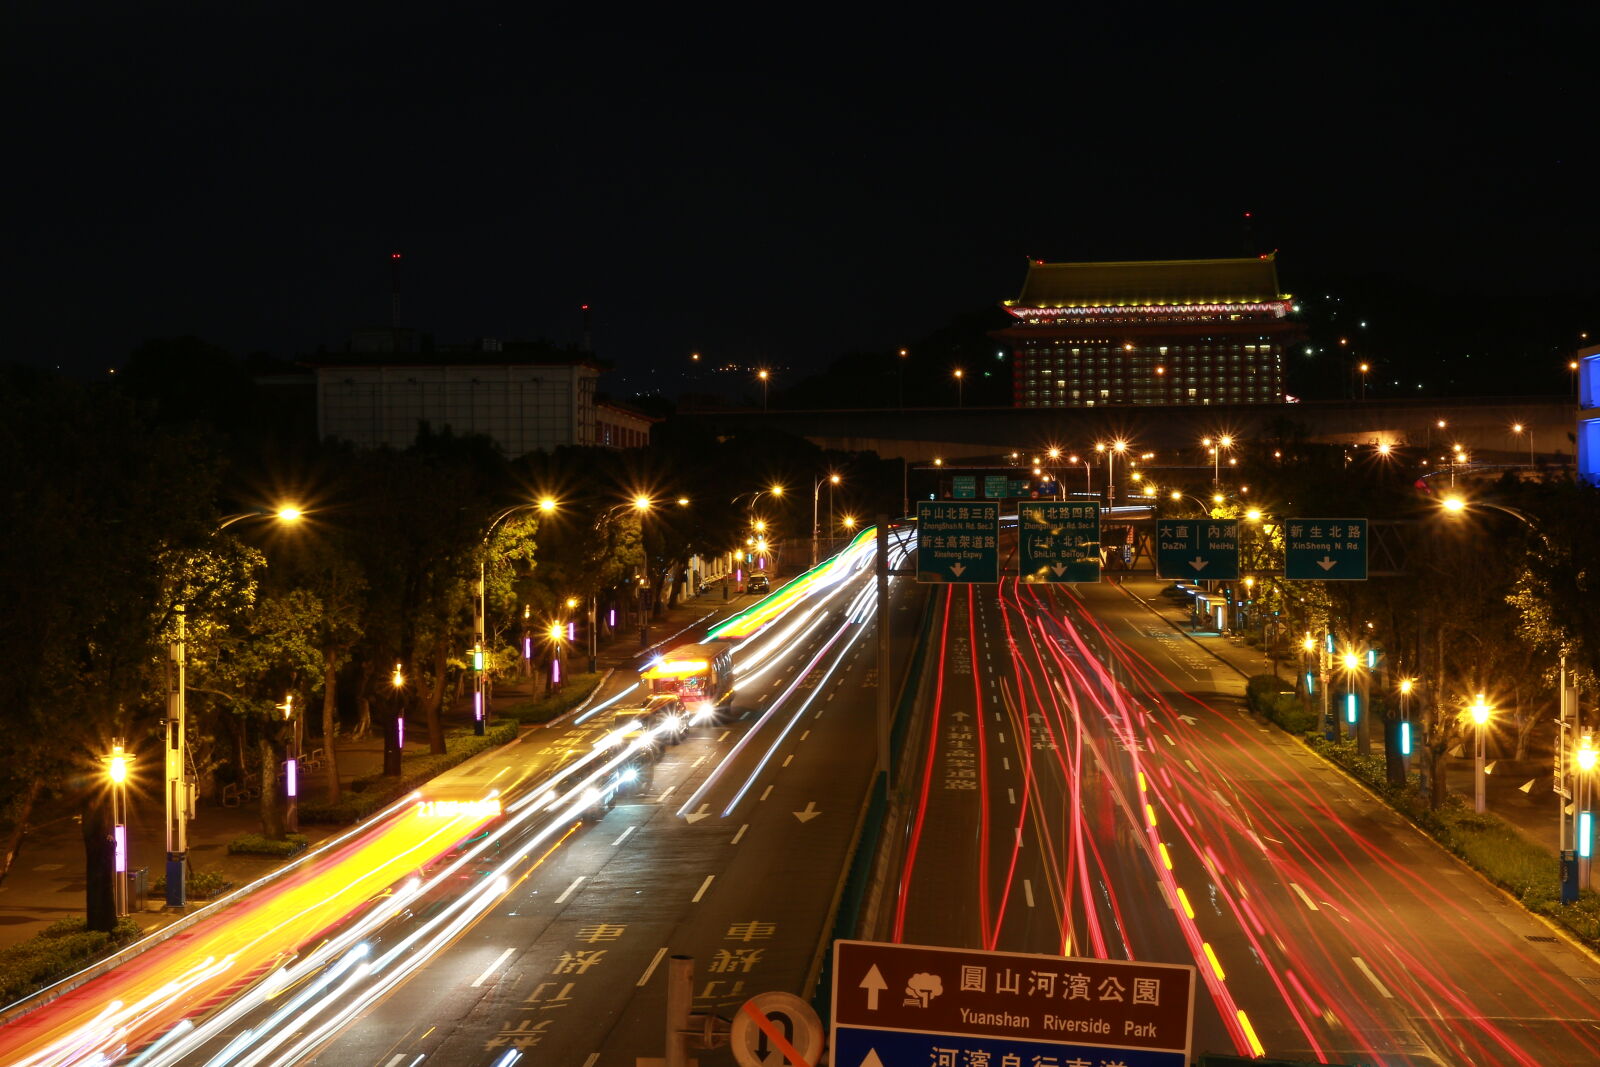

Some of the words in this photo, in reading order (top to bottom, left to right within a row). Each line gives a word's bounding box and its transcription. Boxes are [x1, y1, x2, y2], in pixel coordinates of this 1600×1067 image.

[920, 506, 996, 521] 中山北路三段
[1022, 506, 1096, 520] 中山北路四段
[1160, 524, 1189, 539] 大直
[1207, 524, 1237, 539] 內湖
[1290, 524, 1361, 539] 新生北路
[921, 535, 996, 549] 新生高架道路
[1161, 541, 1188, 550] DaZhi
[1209, 541, 1235, 550] NeiHu
[1292, 541, 1331, 552] XinSheng
[1334, 541, 1343, 550] N.
[960, 965, 1161, 1006] 圓山河濱公園
[960, 1007, 1030, 1029] Yuanshan
[1044, 1013, 1111, 1035] Riverside
[1124, 1020, 1157, 1039] Park
